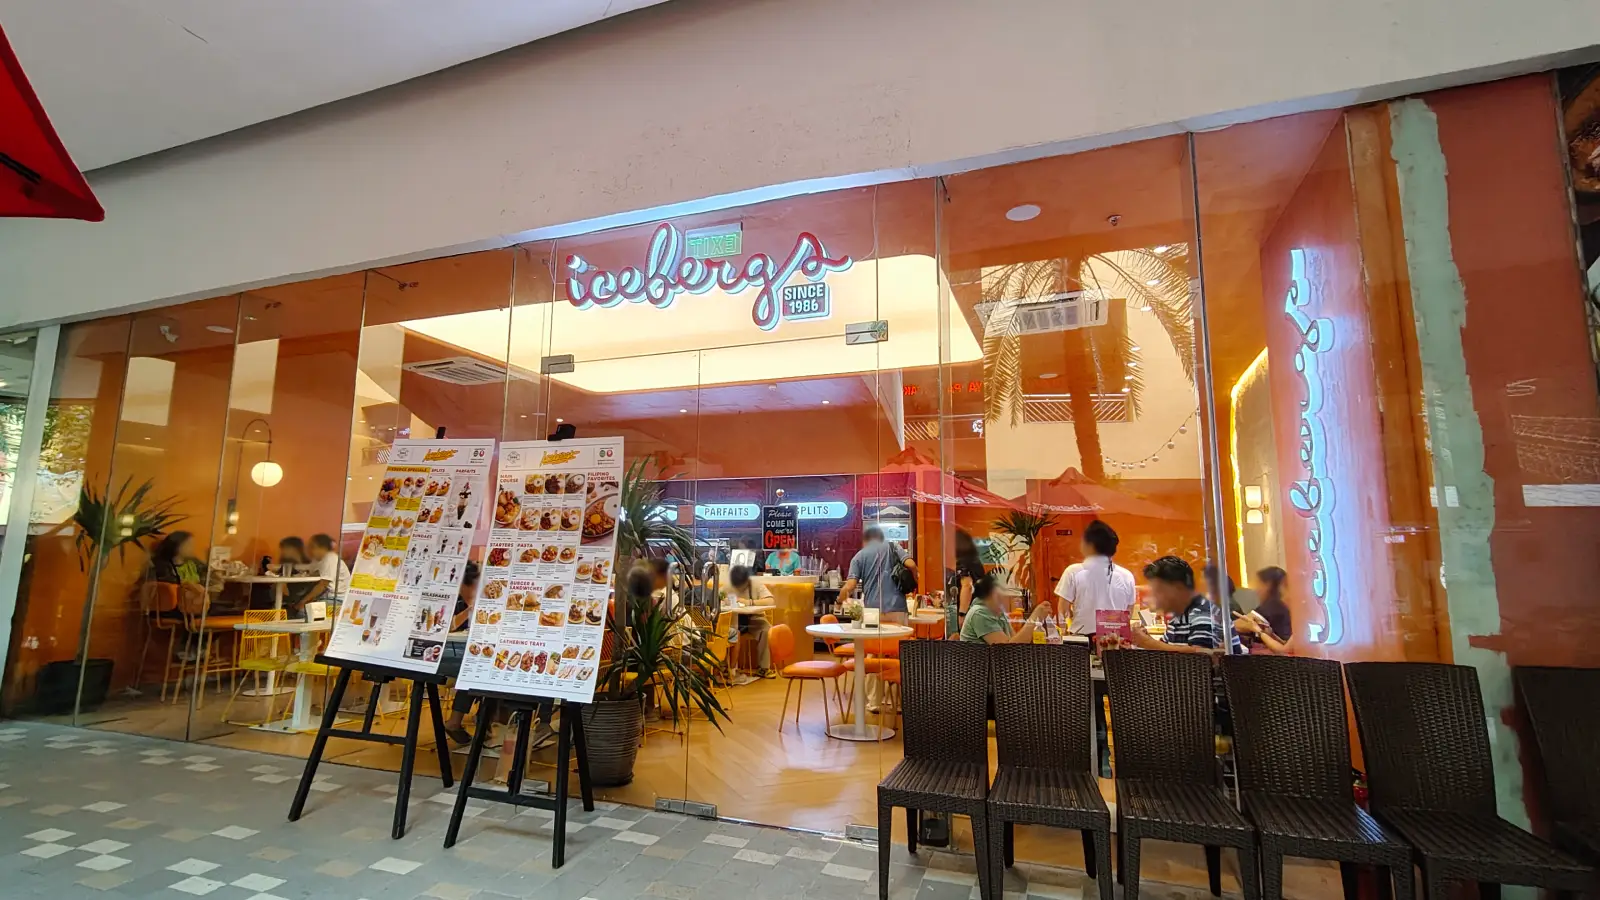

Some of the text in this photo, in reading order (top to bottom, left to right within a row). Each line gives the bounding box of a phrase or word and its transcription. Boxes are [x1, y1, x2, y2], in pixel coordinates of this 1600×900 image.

[783, 284, 825, 302] SINCE
[788, 299, 819, 314] 1986
[704, 507, 749, 517] PARFAITS
[768, 509, 792, 518] Please
[797, 504, 829, 516] SPLITS
[765, 519, 795, 528] COME IN
[774, 527, 794, 535] we're
[765, 530, 796, 549] OPEN
[421, 591, 451, 599] MILKSHAKES
